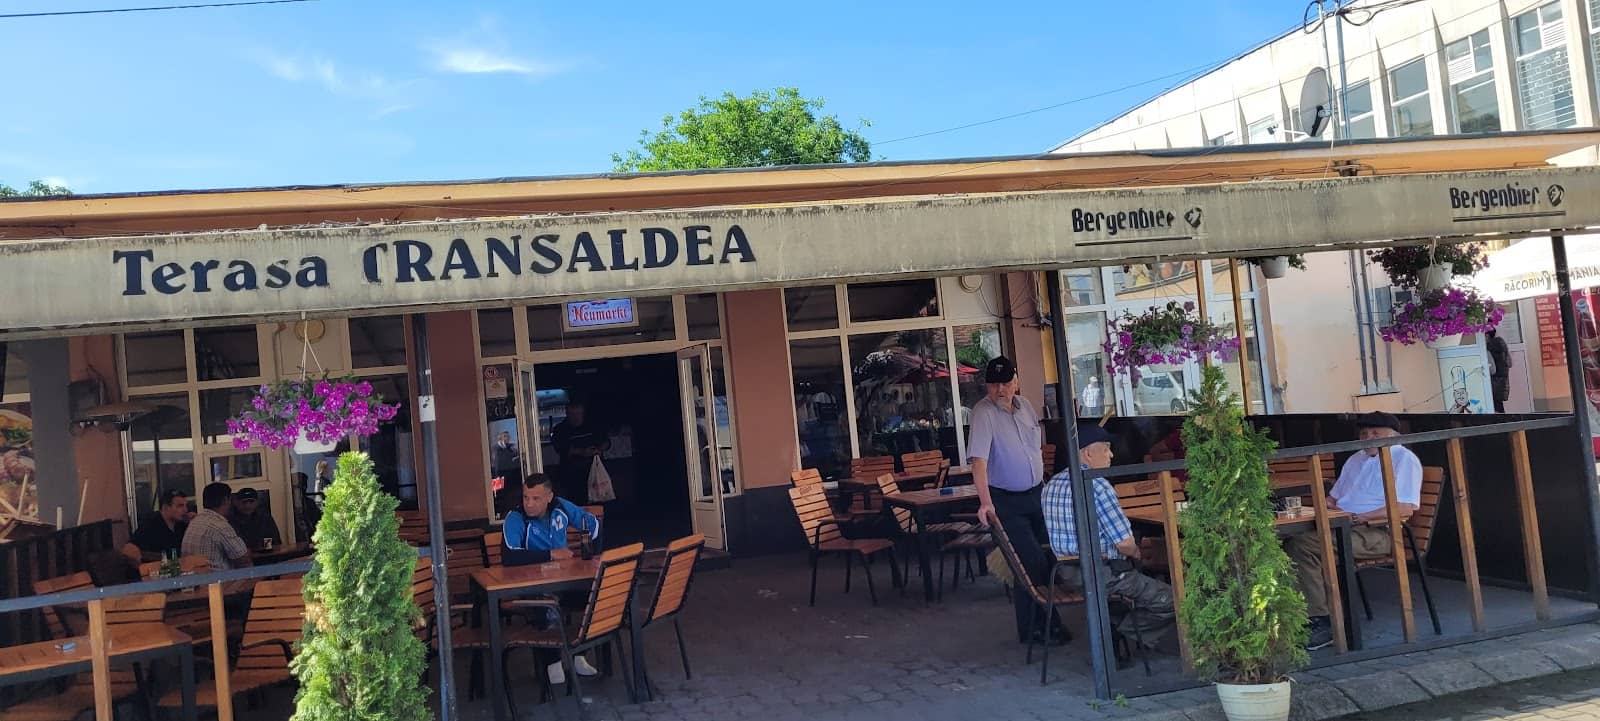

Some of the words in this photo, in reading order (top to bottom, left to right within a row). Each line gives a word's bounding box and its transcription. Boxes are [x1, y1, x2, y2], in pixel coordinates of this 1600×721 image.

[1449, 182, 1540, 212] Bergenbier
[112, 249, 329, 296] Terasa
[572, 304, 628, 322] Neumarkt
